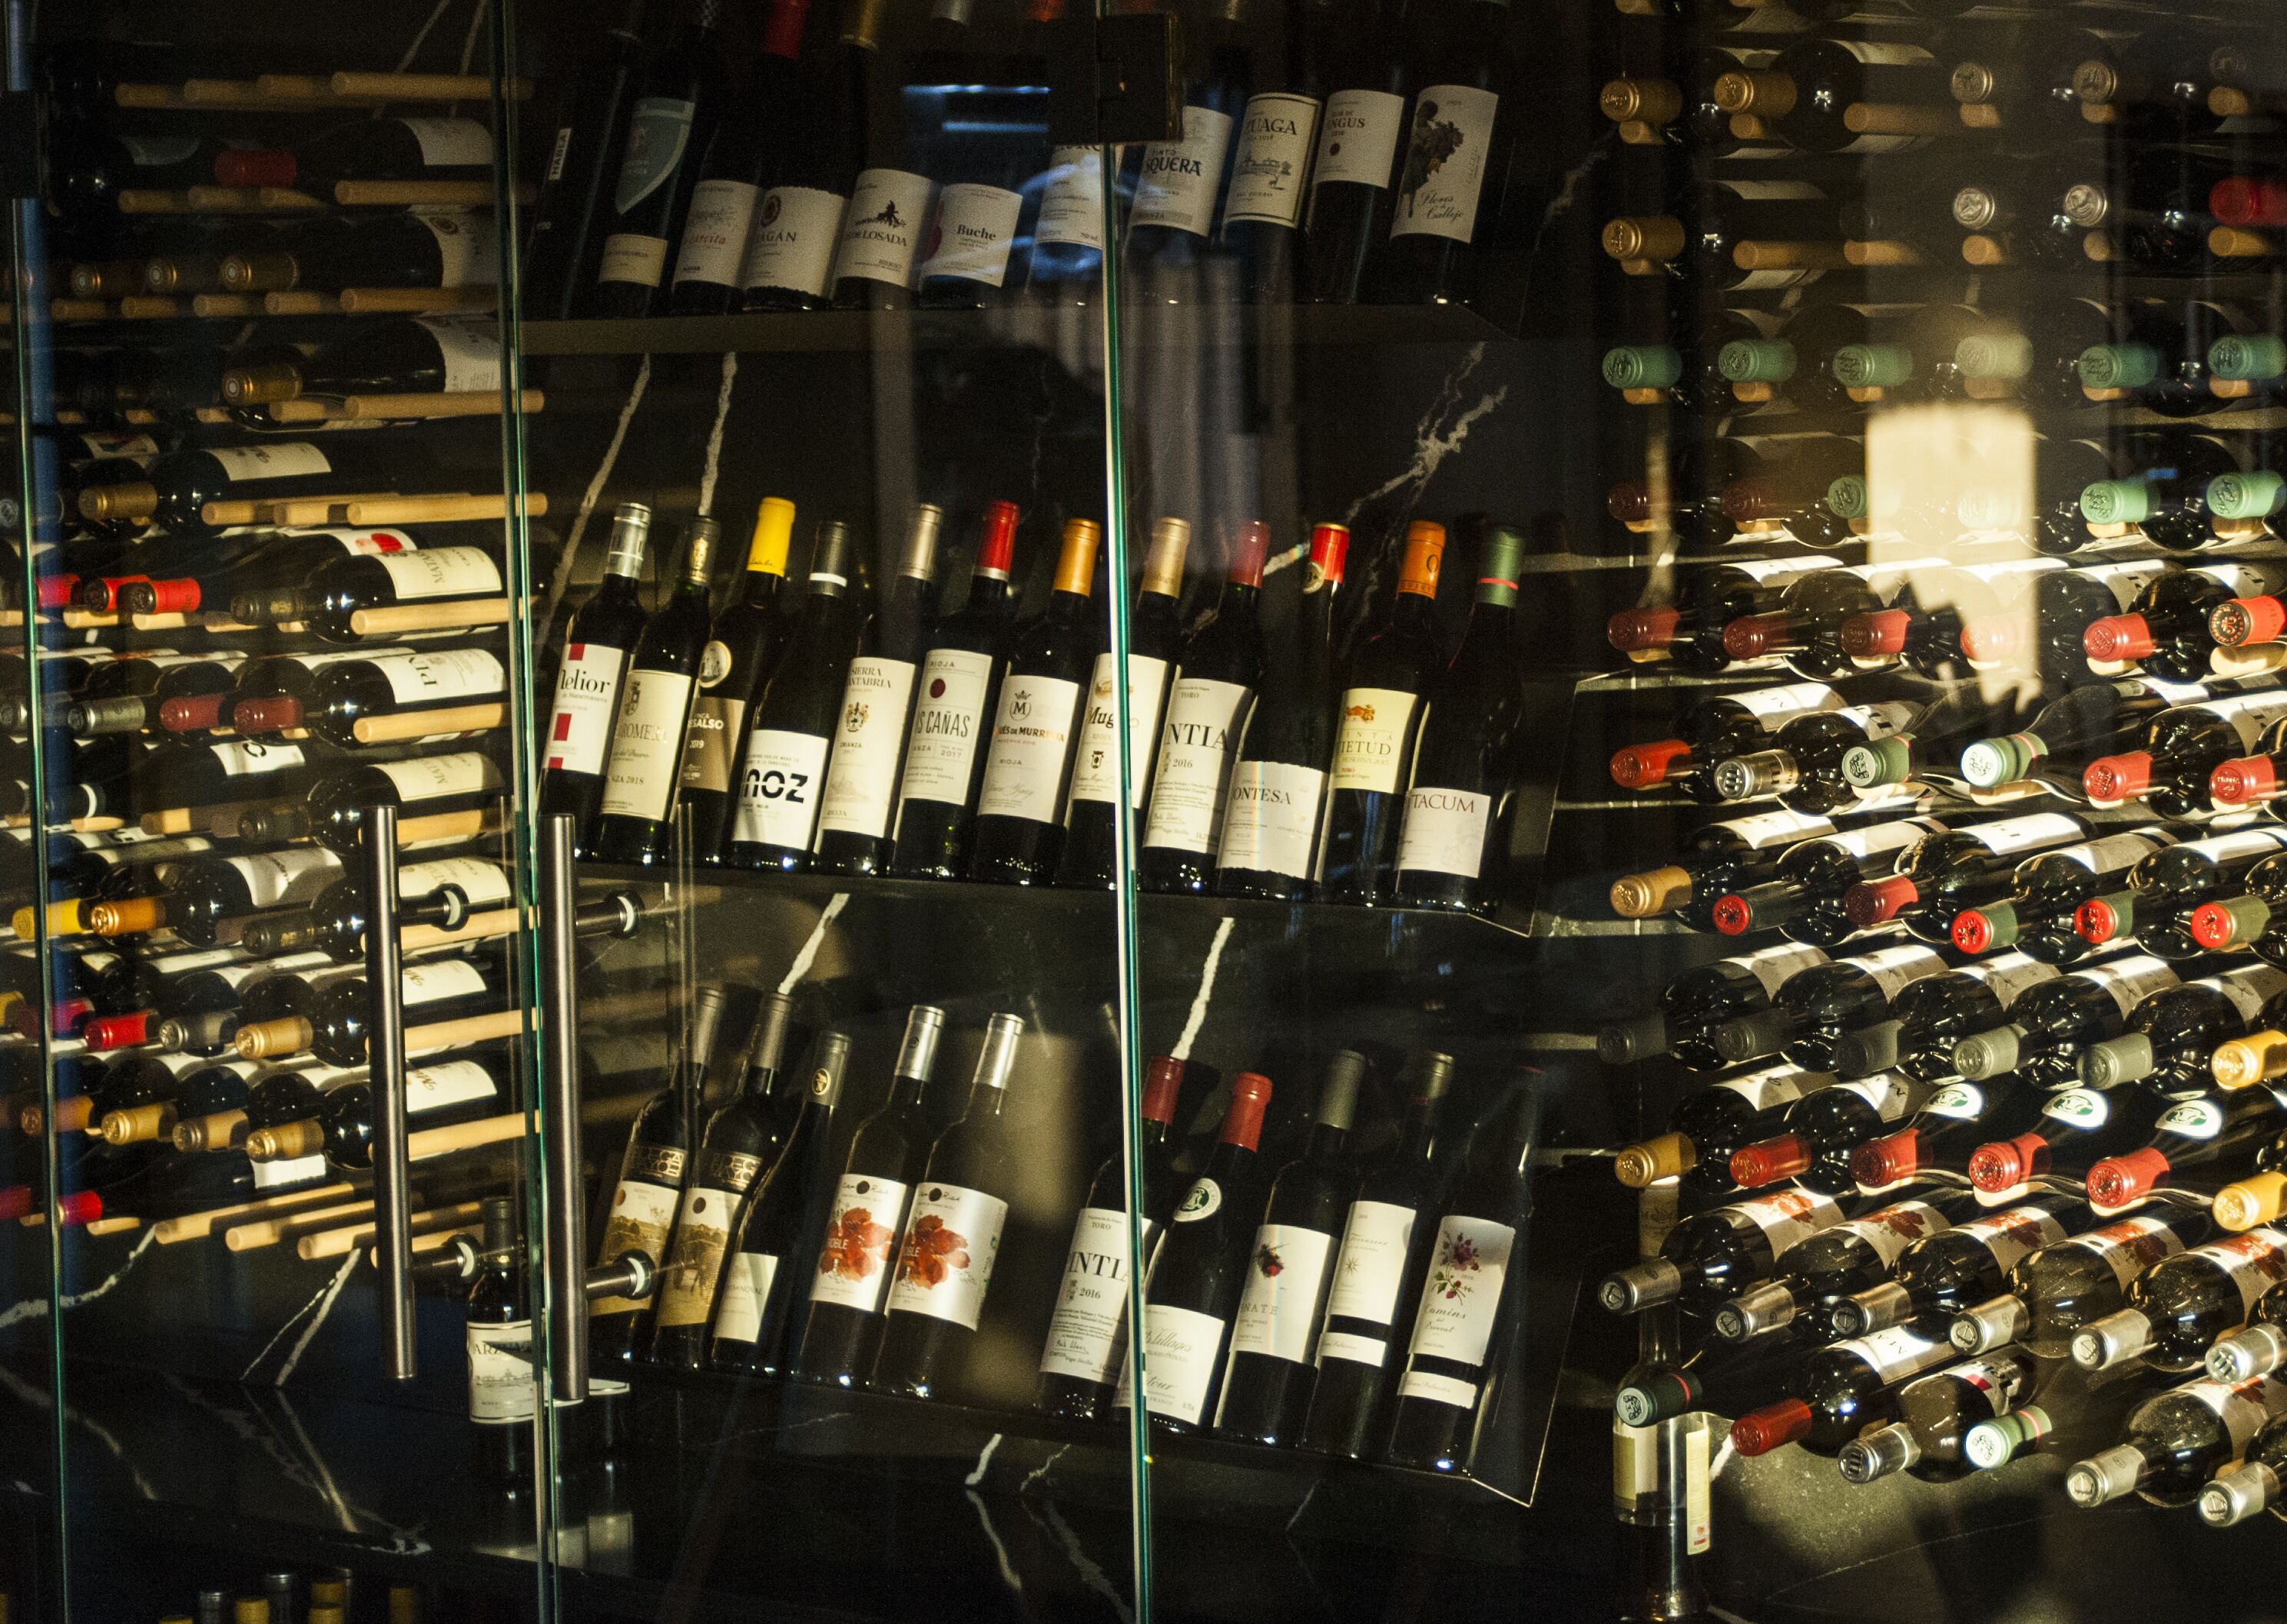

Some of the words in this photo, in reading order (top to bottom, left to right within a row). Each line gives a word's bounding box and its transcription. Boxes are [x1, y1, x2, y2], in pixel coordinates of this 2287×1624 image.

[862, 229, 907, 247] LOSADA
[957, 224, 997, 242] Buche
[618, 722, 667, 742] ROMER
[926, 710, 971, 738] CAÑAS
[1019, 725, 1065, 743] MURRTA
[940, 750, 962, 759] 2017
[1172, 757, 1194, 769] 2016
[1409, 793, 1475, 814] TACUM
[1079, 1288, 1102, 1300] 2016
